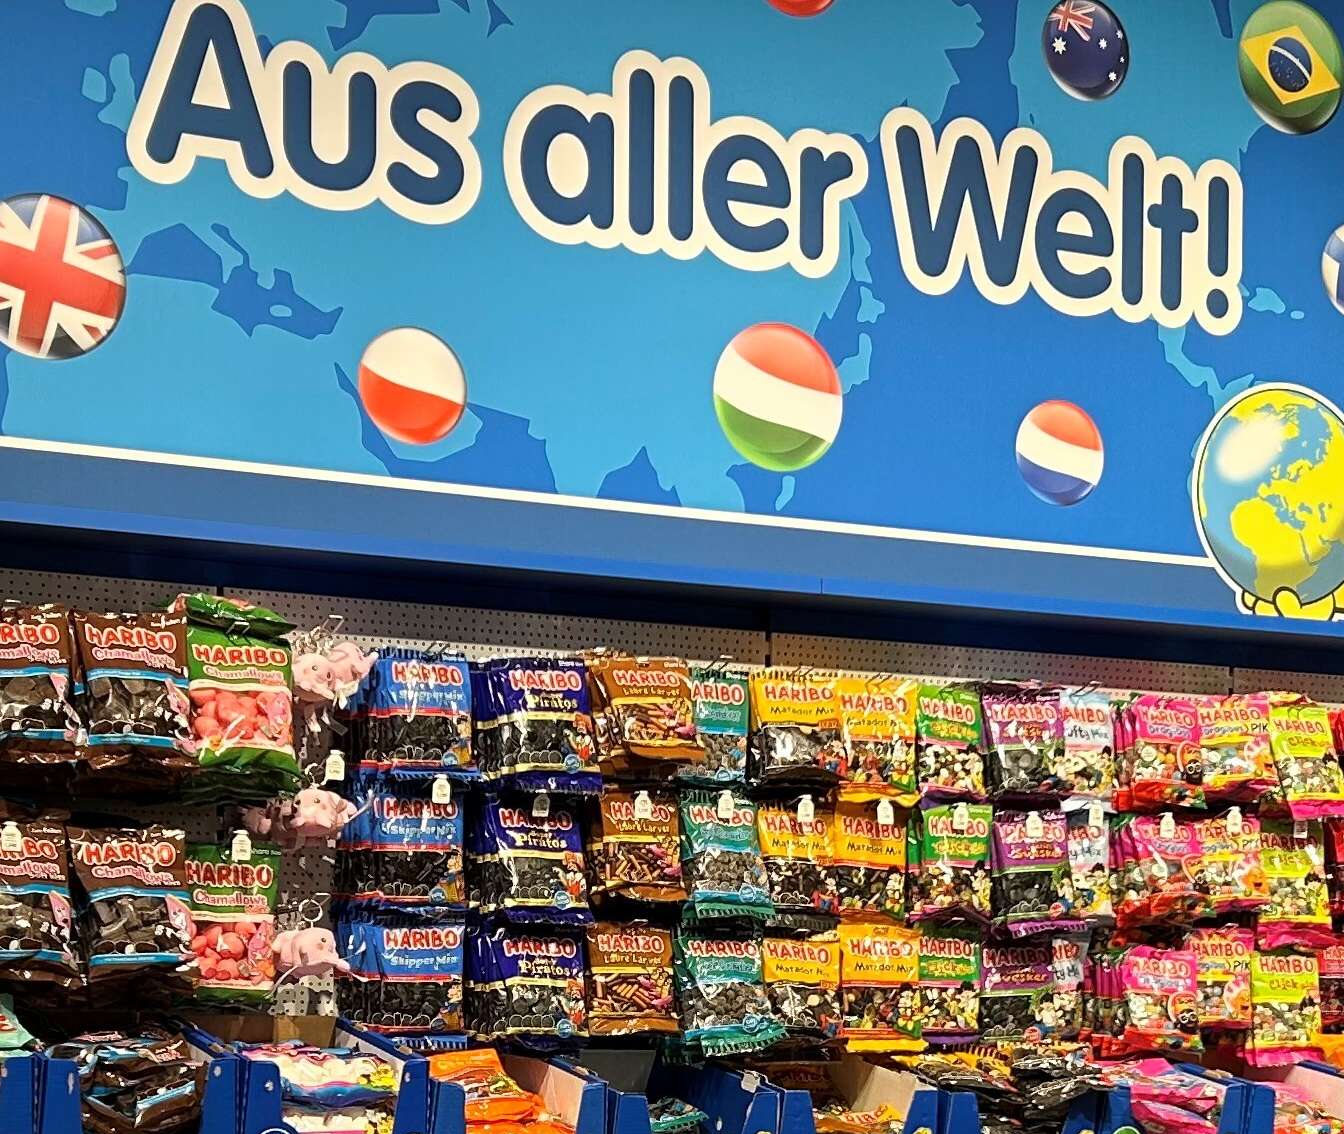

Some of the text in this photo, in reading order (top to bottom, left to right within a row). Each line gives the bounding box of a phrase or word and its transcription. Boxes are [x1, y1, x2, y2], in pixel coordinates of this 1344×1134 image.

[144, 2, 1230, 319] Aus aller Welt!
[83, 627, 177, 658] HARIBO
[192, 642, 288, 669] HARIBO
[529, 693, 577, 711] Piratos
[766, 685, 834, 708] HARIBO
[81, 837, 175, 866] HARIBO
[514, 832, 567, 850] Piratos
[185, 860, 275, 887] HARIBO
[384, 929, 460, 950] HARIBO
[768, 943, 828, 965] HARIBO
[518, 959, 570, 978] Piratos
